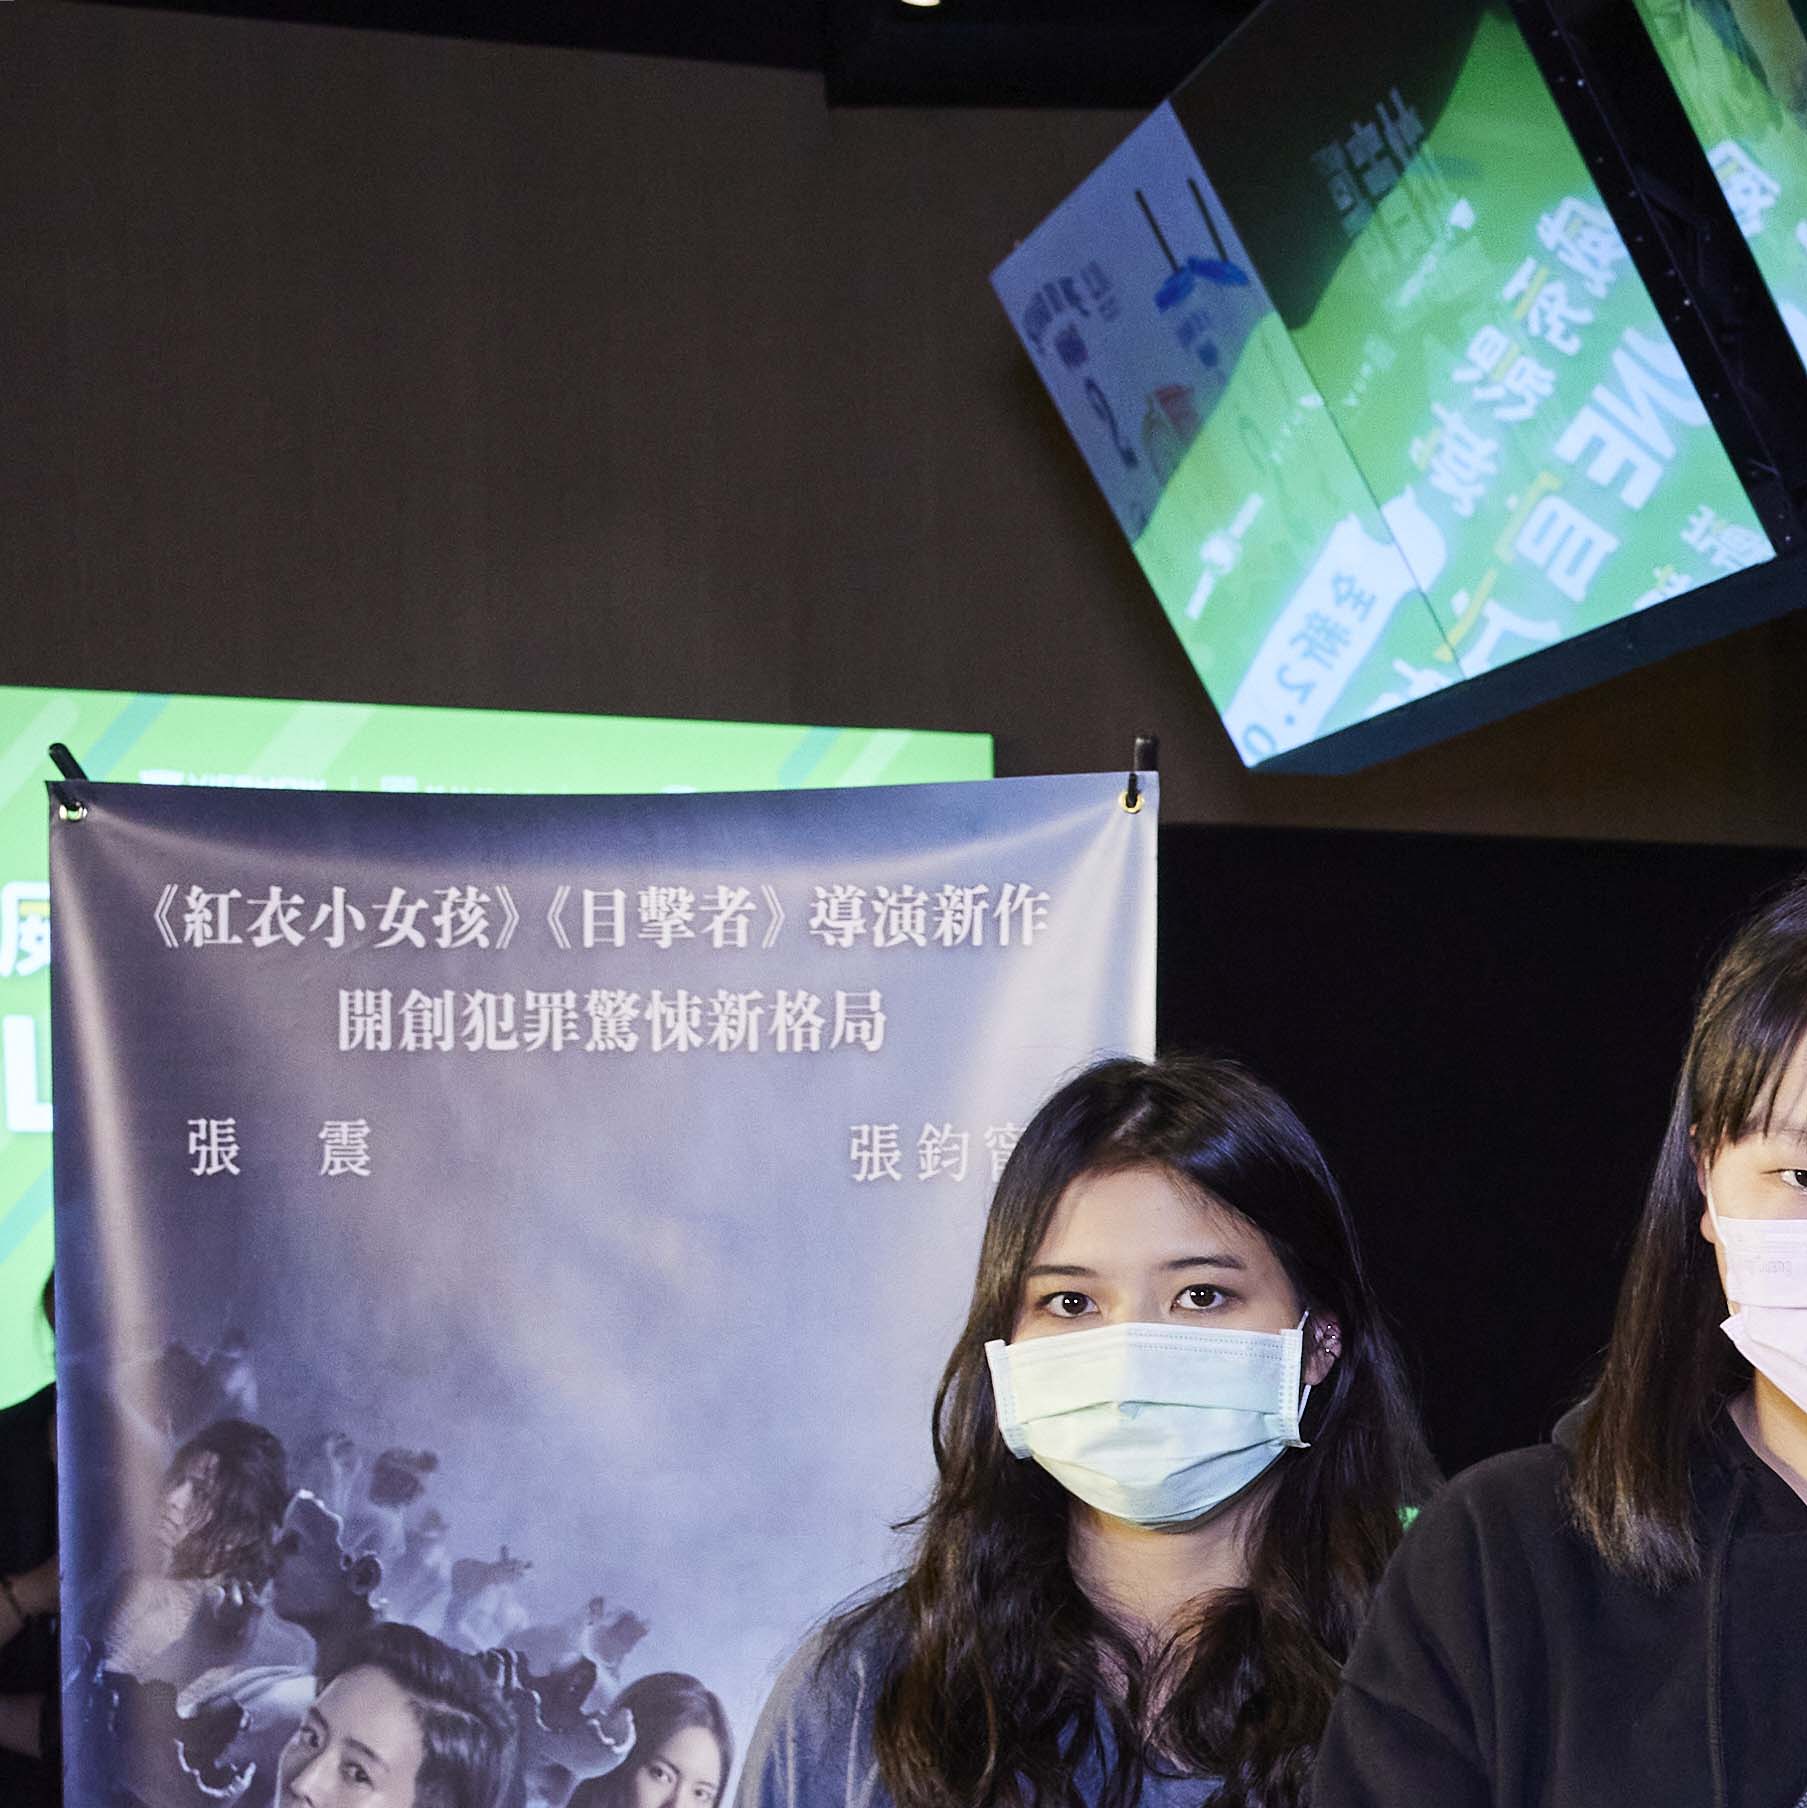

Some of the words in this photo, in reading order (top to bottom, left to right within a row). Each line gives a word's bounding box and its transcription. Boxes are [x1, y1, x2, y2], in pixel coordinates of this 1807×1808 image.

[153, 883, 521, 950] 《紅衣小女孩》
[546, 884, 787, 950] 《目擊者》
[808, 882, 1051, 947] 導演新作
[338, 988, 888, 1054] 開創犯罪驚悚新格局
